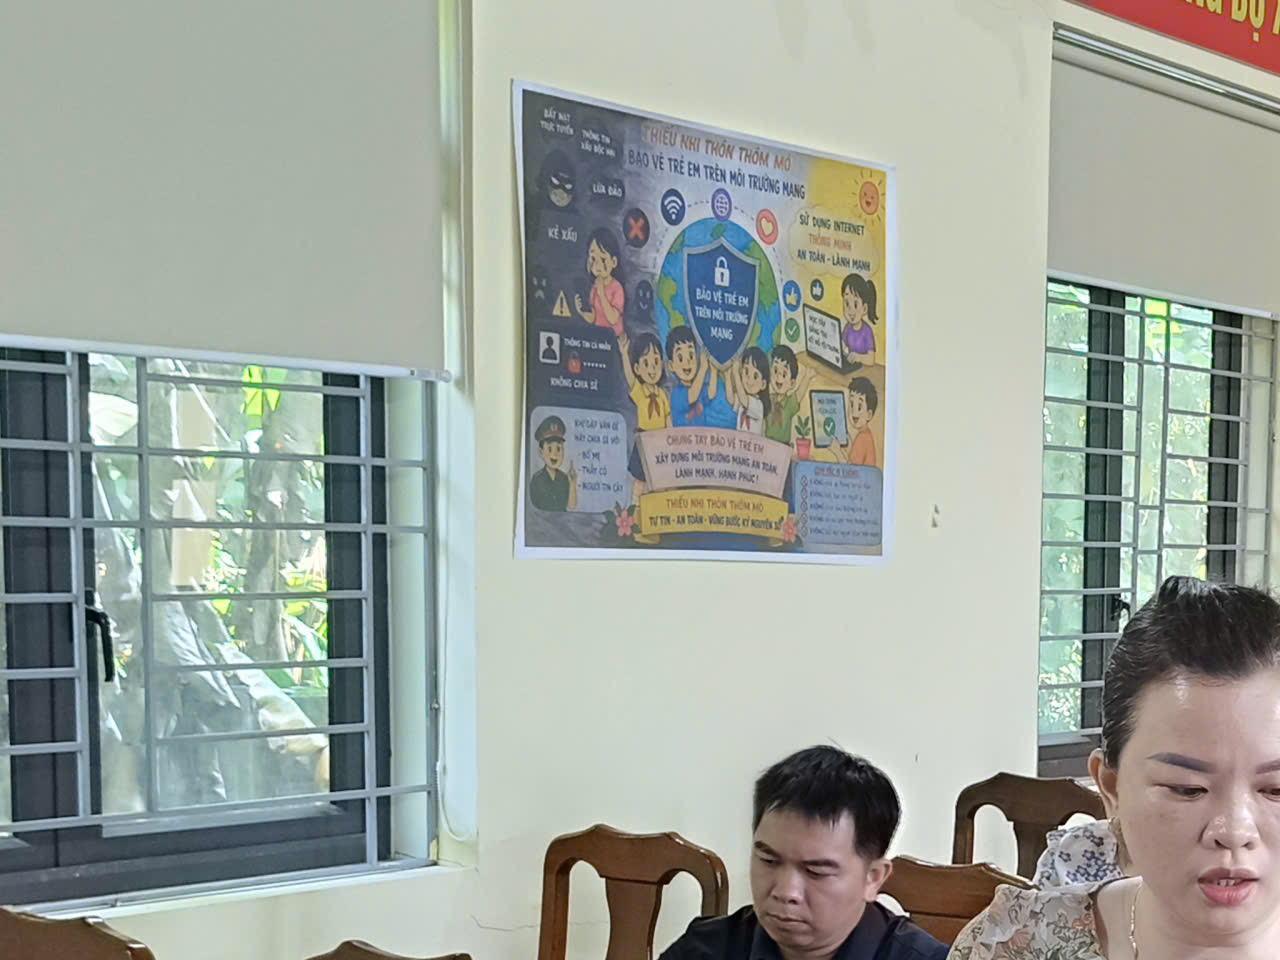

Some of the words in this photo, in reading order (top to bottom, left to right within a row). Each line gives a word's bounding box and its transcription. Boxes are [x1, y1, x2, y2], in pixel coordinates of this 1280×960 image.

[642, 125, 678, 147] THIẾU
[680, 134, 701, 152] NHI
[705, 139, 735, 160] THÔN
[667, 154, 685, 175] TRẺ
[687, 161, 701, 179] EM
[703, 163, 727, 183] TRÊN
[729, 168, 745, 188] MÔI
[748, 172, 780, 195] TRƯỜNG
[782, 181, 806, 200] MẠNG
[833, 220, 865, 236] INTERNET
[797, 249, 806, 260] AN
[695, 284, 712, 301] BẢO
[713, 290, 723, 304] VỆ
[724, 291, 737, 305] TRẺ
[738, 295, 749, 307] EM
[695, 304, 711, 319] TRÊN
[725, 310, 749, 325] TRƯỜNG
[711, 326, 733, 342] MẠNG
